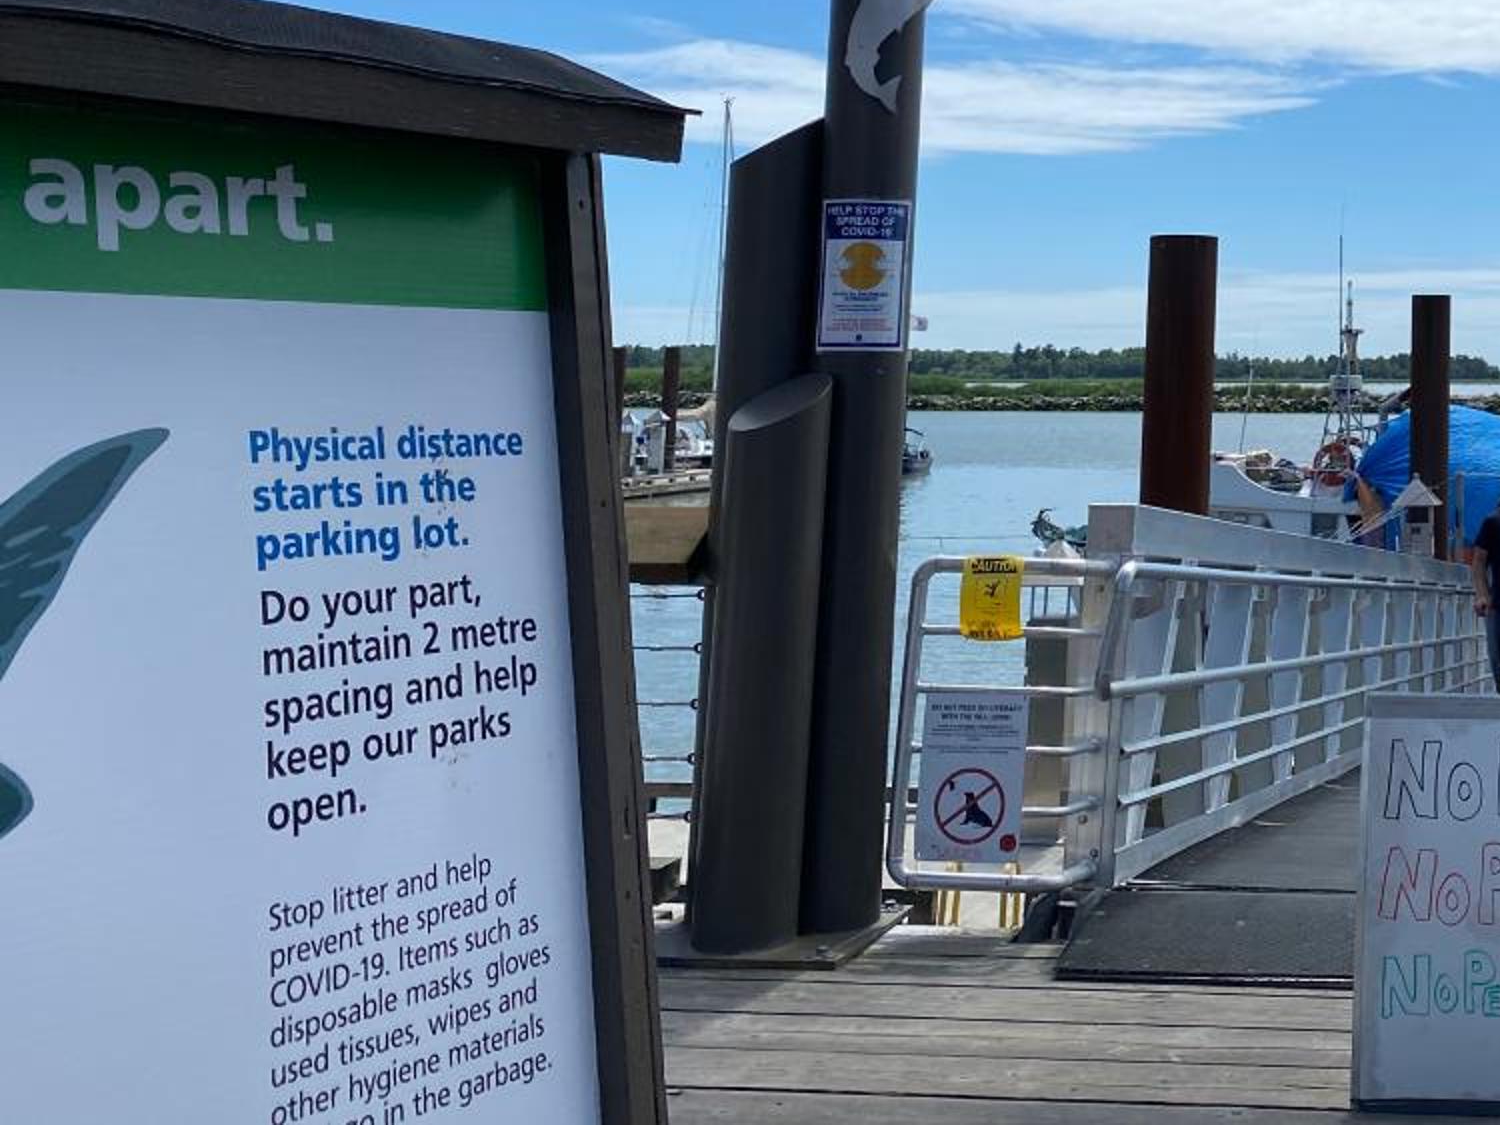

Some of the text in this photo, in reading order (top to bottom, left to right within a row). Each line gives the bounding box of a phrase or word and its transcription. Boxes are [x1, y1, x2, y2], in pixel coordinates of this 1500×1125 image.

[23, 157, 335, 252] apart.
[836, 216, 879, 226] SPREAD
[841, 226, 893, 237] COVID-19
[855, 206, 885, 216] STOP
[249, 425, 523, 472] Physical distance
[253, 470, 476, 512] starts in the
[256, 514, 469, 572] parking lot.
[260, 575, 482, 628] Do your part,
[262, 616, 538, 676] maintain 2 metre
[264, 655, 538, 735] spacing and help
[266, 705, 512, 780] keep our parks
[267, 786, 368, 837] open.
[269, 853, 492, 932] Stop litter and help
[270, 877, 518, 977] prevent the spread of
[270, 913, 540, 1008] COVID-19. Items such as
[270, 943, 551, 1049] disposable masks gloves
[270, 1013, 545, 1125] other hygiene materials
[271, 977, 538, 1088] used tissues, wipes and
[383, 1100, 405, 1125] in
[412, 1085, 452, 1117] the
[458, 1051, 553, 1109] garbage.
